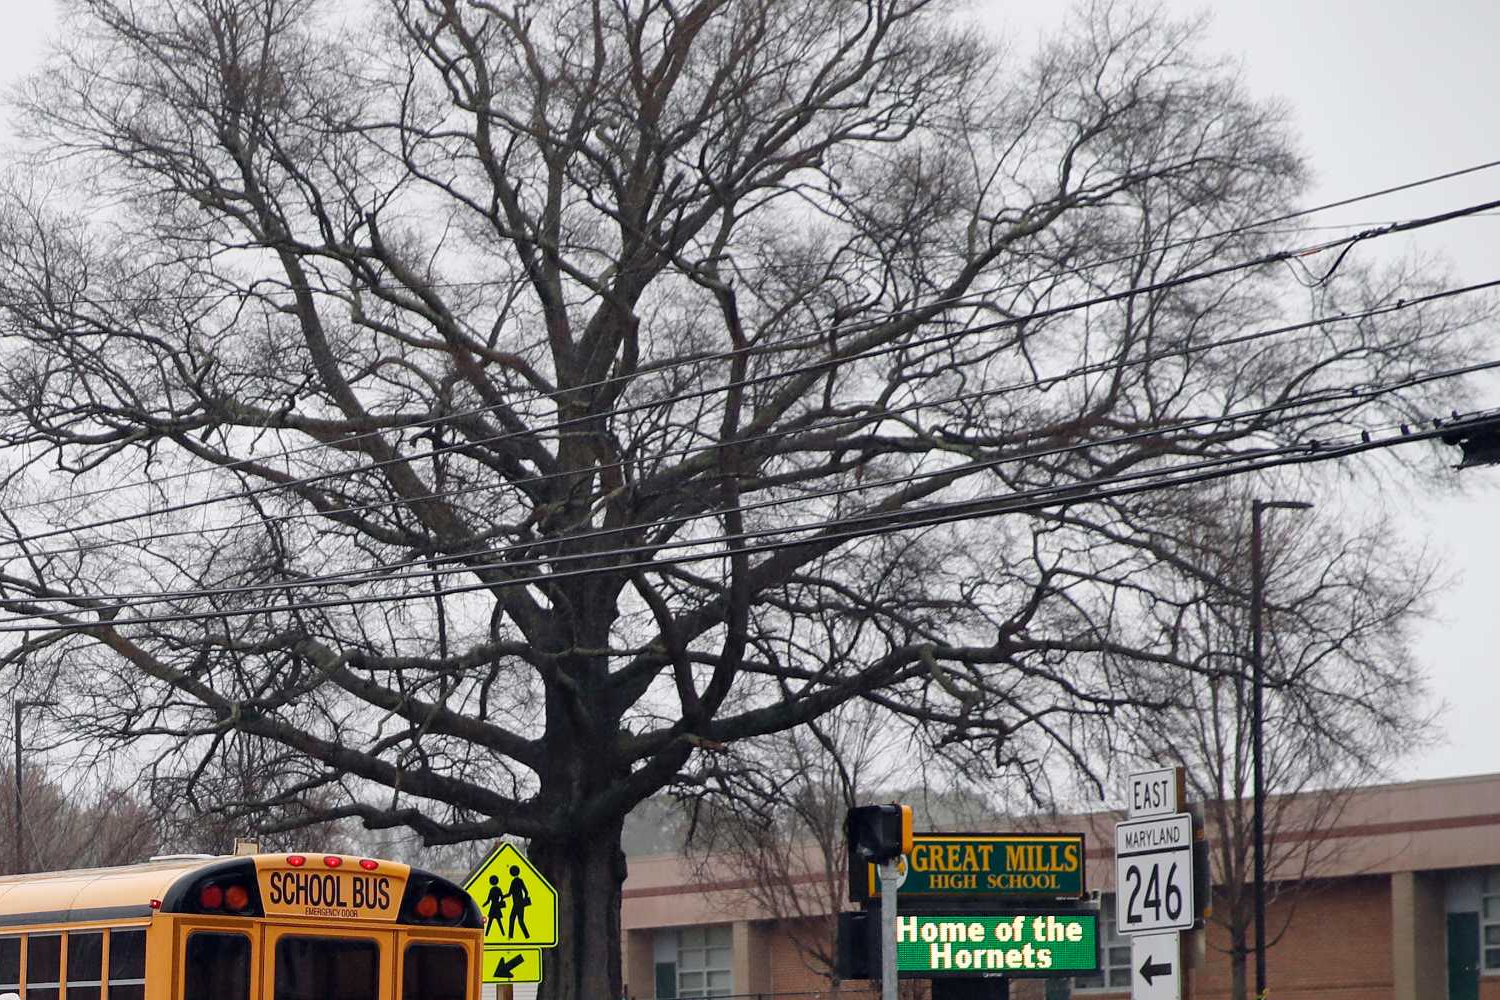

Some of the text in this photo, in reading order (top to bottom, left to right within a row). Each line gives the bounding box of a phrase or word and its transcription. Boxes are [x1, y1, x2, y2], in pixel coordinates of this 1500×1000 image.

[1134, 780, 1168, 809] EAST
[1125, 826, 1180, 848] MARYLAND
[911, 845, 1078, 872] GREAT MILLS
[270, 872, 390, 910] SCHOOL BUS
[929, 874, 1060, 889] HIGH SCHOOL
[1126, 862, 1182, 923] 246
[305, 908, 340, 917] EMERGENCY
[896, 916, 1083, 942] Home of the
[930, 943, 1052, 969] Hornets
